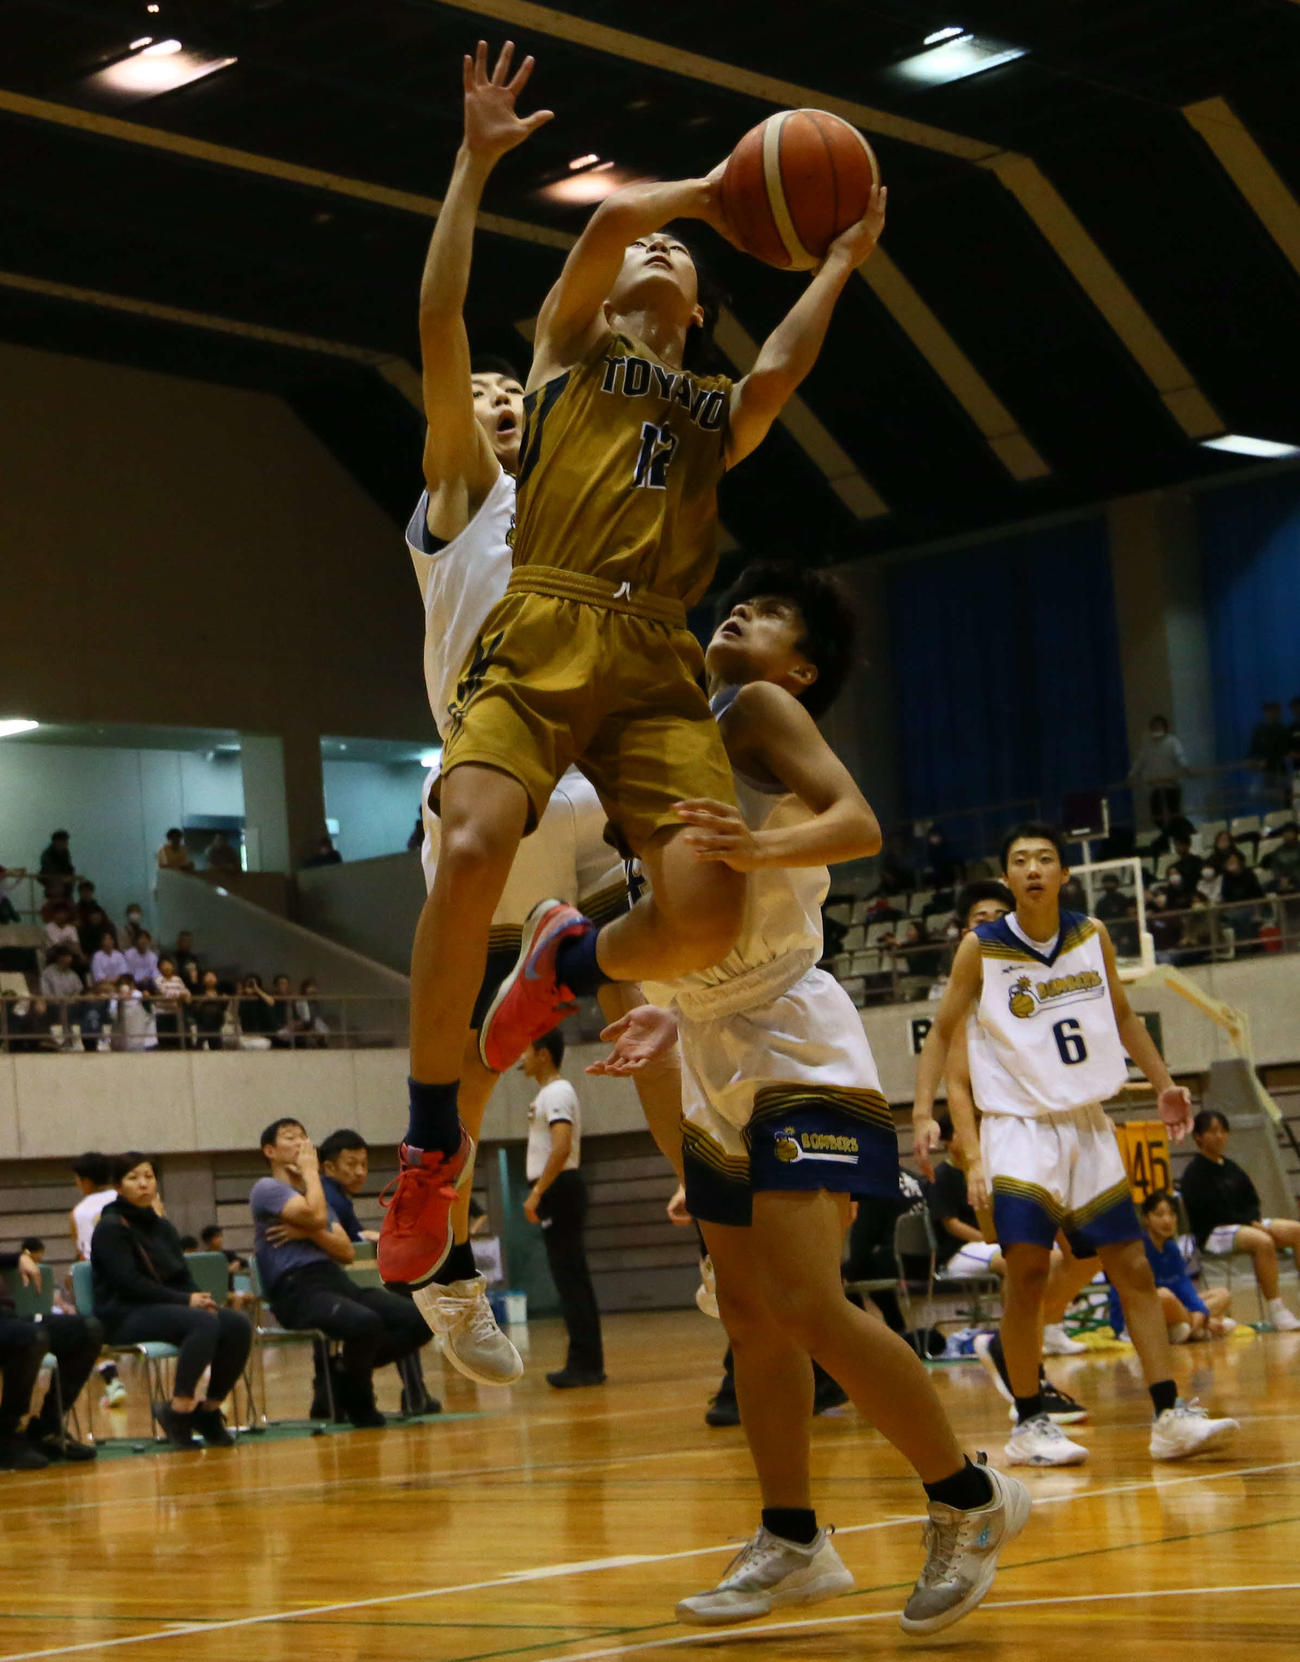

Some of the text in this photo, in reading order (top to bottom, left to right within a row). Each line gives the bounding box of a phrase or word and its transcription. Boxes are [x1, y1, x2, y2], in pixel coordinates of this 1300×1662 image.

[632, 420, 680, 490] 12
[1053, 1018, 1088, 1065] 6
[801, 1132, 859, 1153] BOMBERS
